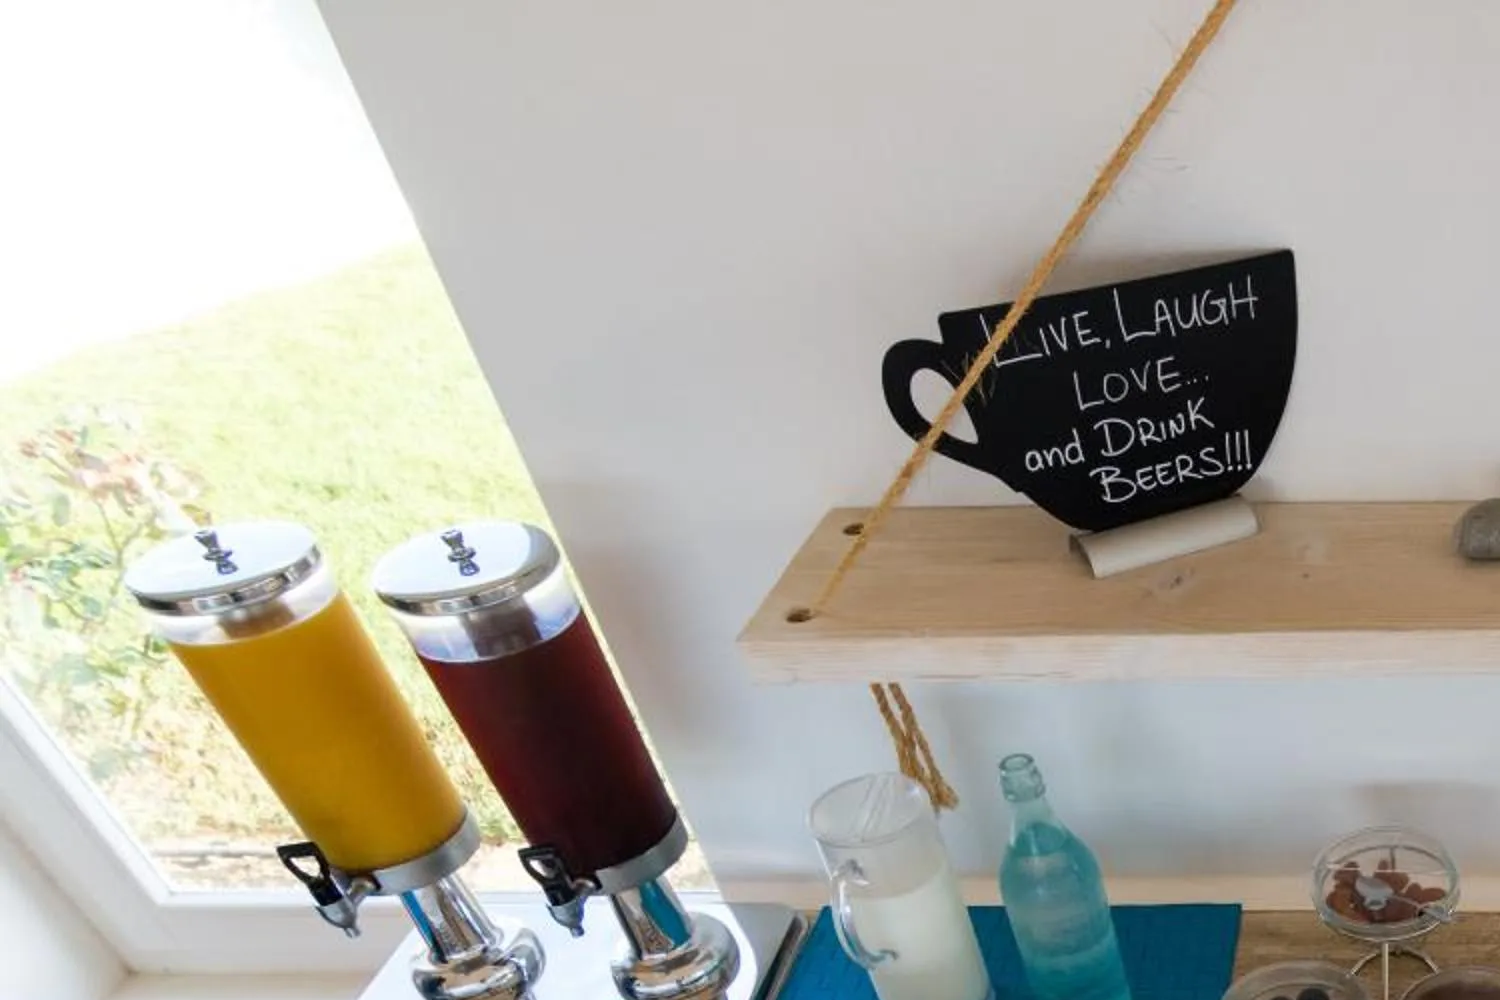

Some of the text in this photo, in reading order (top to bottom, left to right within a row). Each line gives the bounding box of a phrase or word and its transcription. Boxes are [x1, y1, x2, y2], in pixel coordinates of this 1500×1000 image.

[1113, 274, 1259, 342] LAUGH
[1025, 396, 1216, 473] and DRINK
[1089, 429, 1254, 503] BEERS!!!
